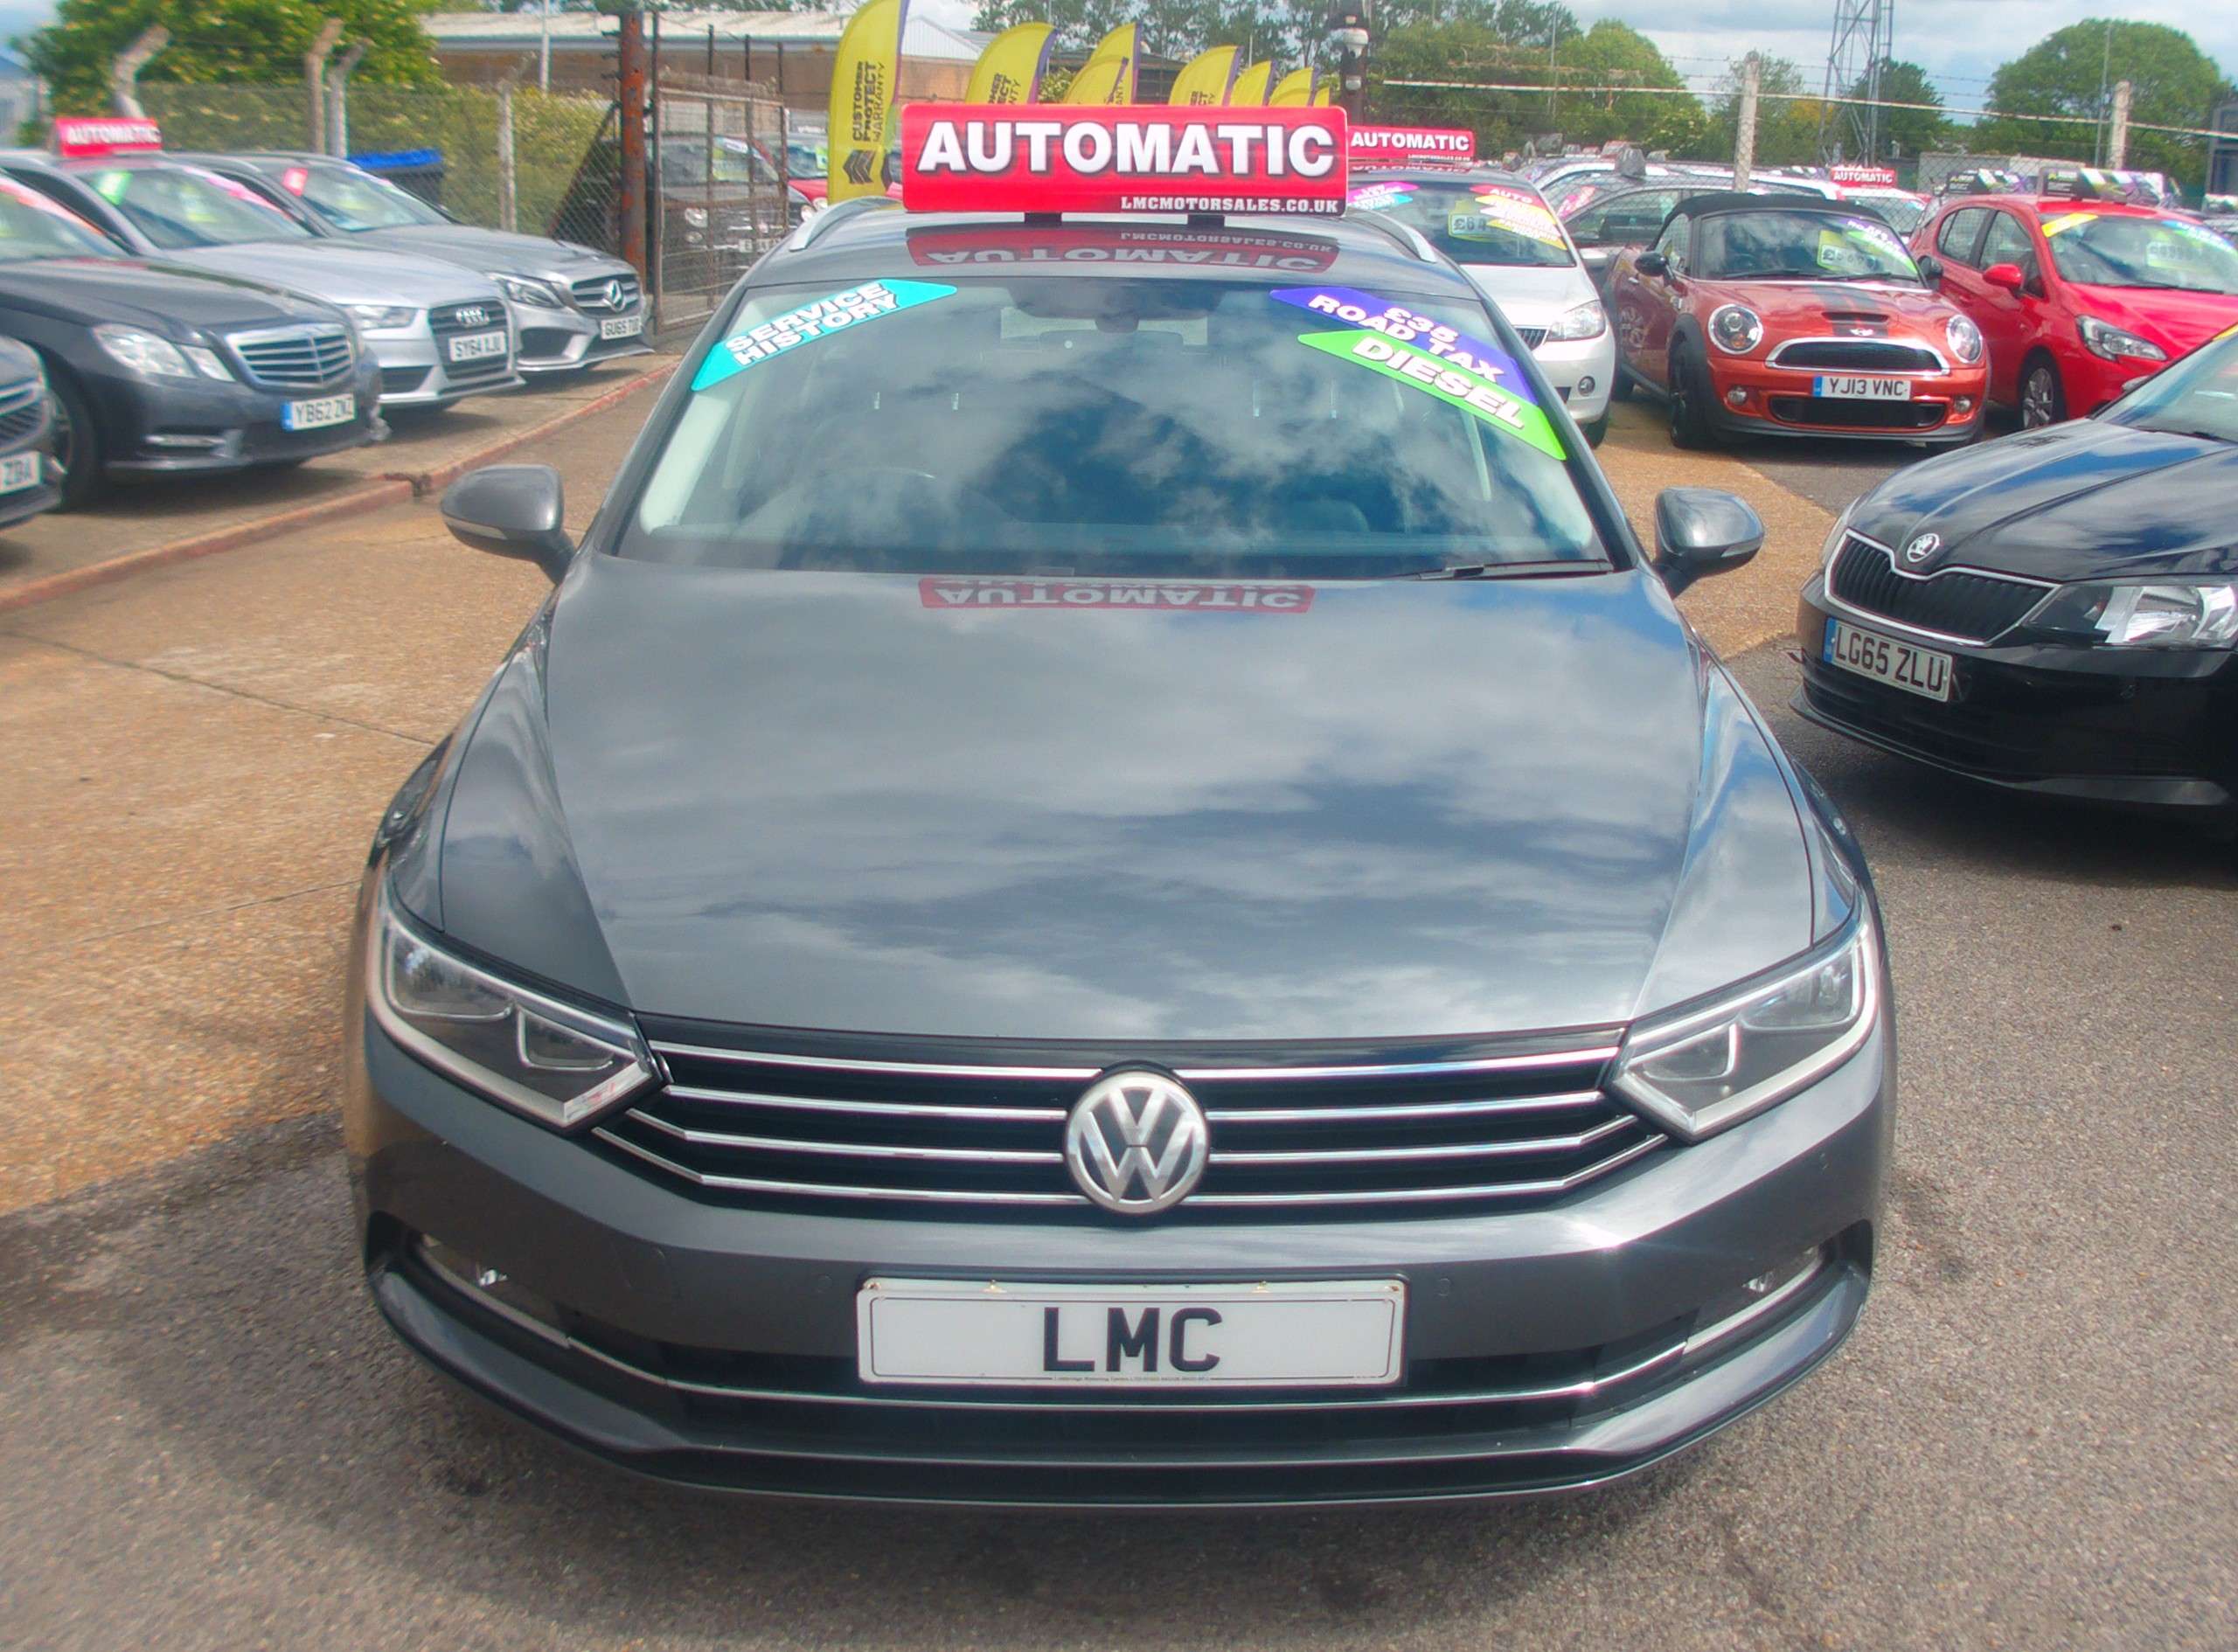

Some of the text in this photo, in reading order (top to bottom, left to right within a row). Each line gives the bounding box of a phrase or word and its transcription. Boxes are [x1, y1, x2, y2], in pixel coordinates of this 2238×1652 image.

[853, 60, 863, 141] CUSTOMER
[863, 61, 876, 142] PROTECT
[872, 61, 885, 142] WARRANTY
[67, 125, 161, 145] AUTOMATIC
[916, 121, 1335, 177] AUTOMATIC
[1351, 132, 1470, 151] AUTOMATIC
[1121, 196, 1339, 213] LMCMOTORSALES.CO.UK
[1490, 188, 1533, 204] AUTO
[1833, 171, 1893, 184] AUTOMATIC
[725, 281, 891, 352] SERVICE
[733, 293, 901, 366] HISTORY
[1308, 294, 1505, 383] ROAD TAX
[1383, 307, 1459, 344] £35
[295, 401, 331, 422] YB62
[1352, 336, 1526, 429] DIESEL
[1829, 378, 1904, 397] YJ13 VNC
[1835, 626, 1945, 693] LG65 ZLU
[1043, 1306, 1223, 1373] LMC
